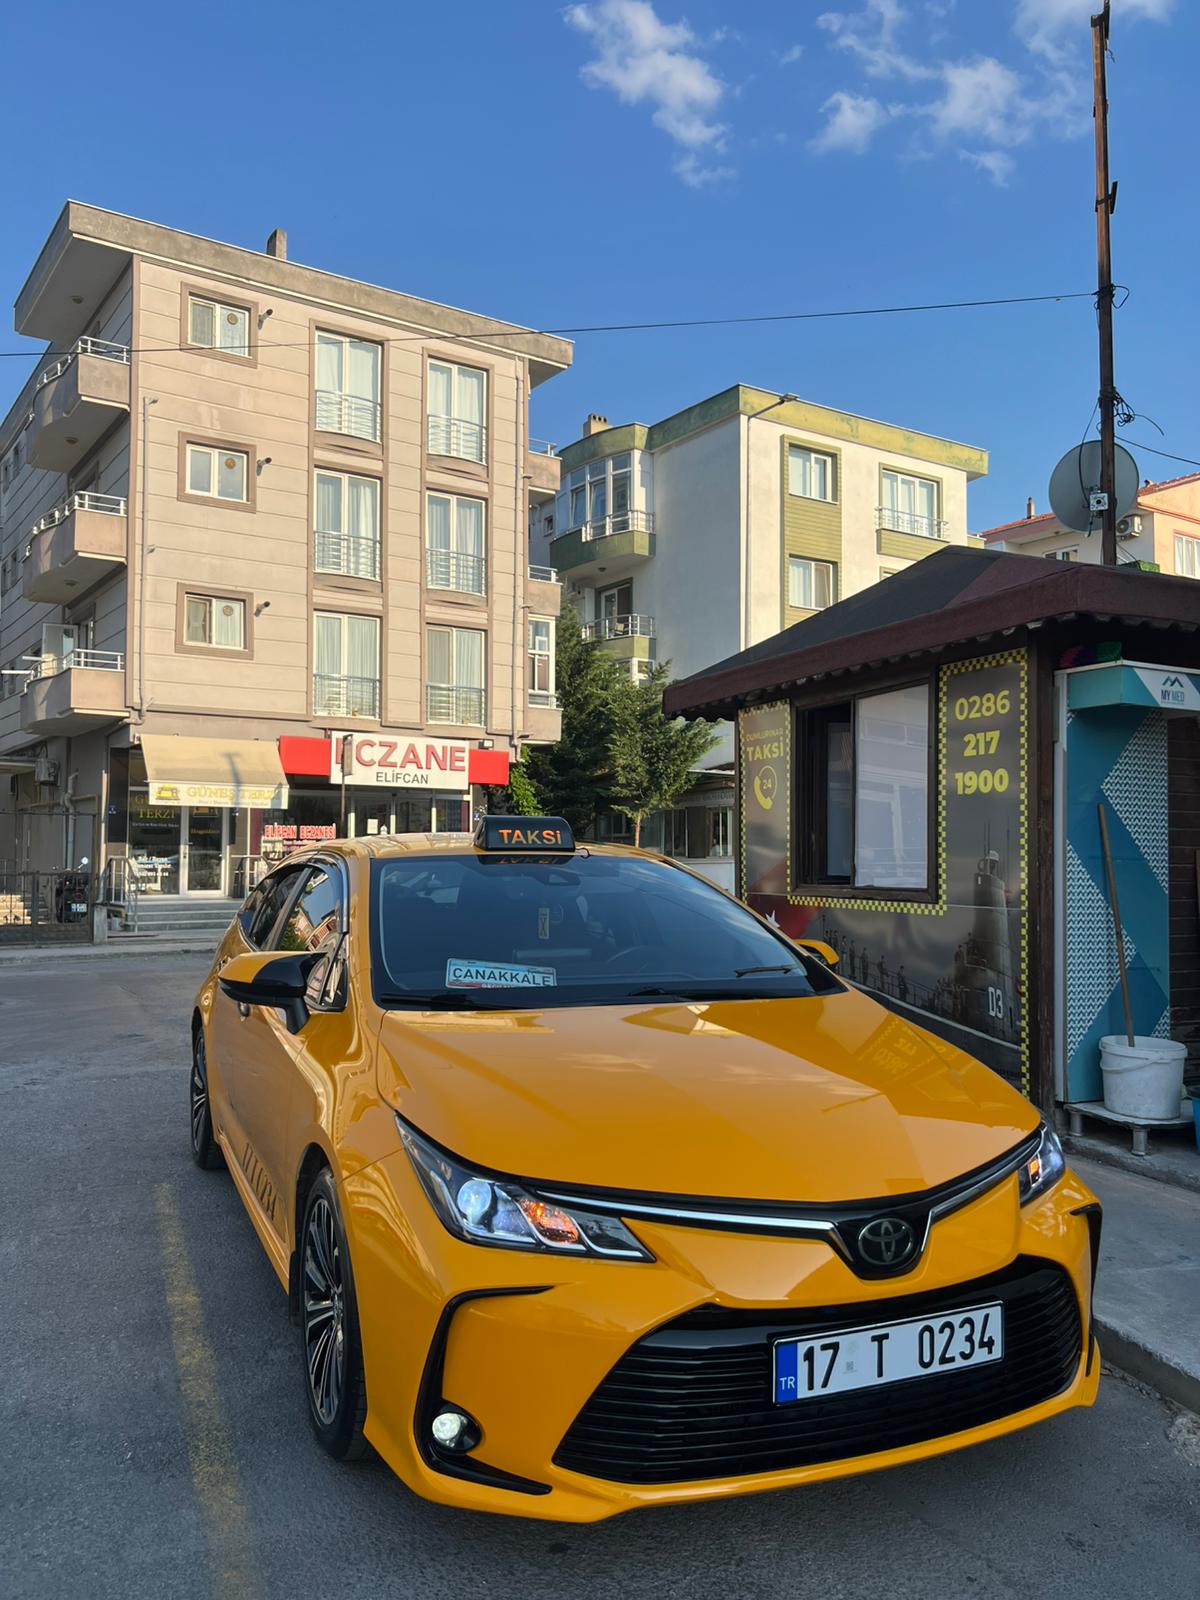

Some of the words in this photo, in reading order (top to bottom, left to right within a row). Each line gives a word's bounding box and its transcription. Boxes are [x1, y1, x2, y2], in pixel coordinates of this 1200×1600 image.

[955, 690, 1010, 720] 0286
[1161, 689, 1171, 701] MY
[747, 737, 784, 761] TAKSİ
[963, 730, 1000, 757] 217
[375, 770, 429, 785] ELİFCAN
[763, 779, 772, 790] 24
[955, 768, 1009, 795] 1900
[988, 986, 1004, 1019] D3
[803, 1341, 840, 1391] 17
[870, 1332, 890, 1378] T
[918, 1312, 995, 1370] 0234
[780, 1376, 796, 1390] TR
